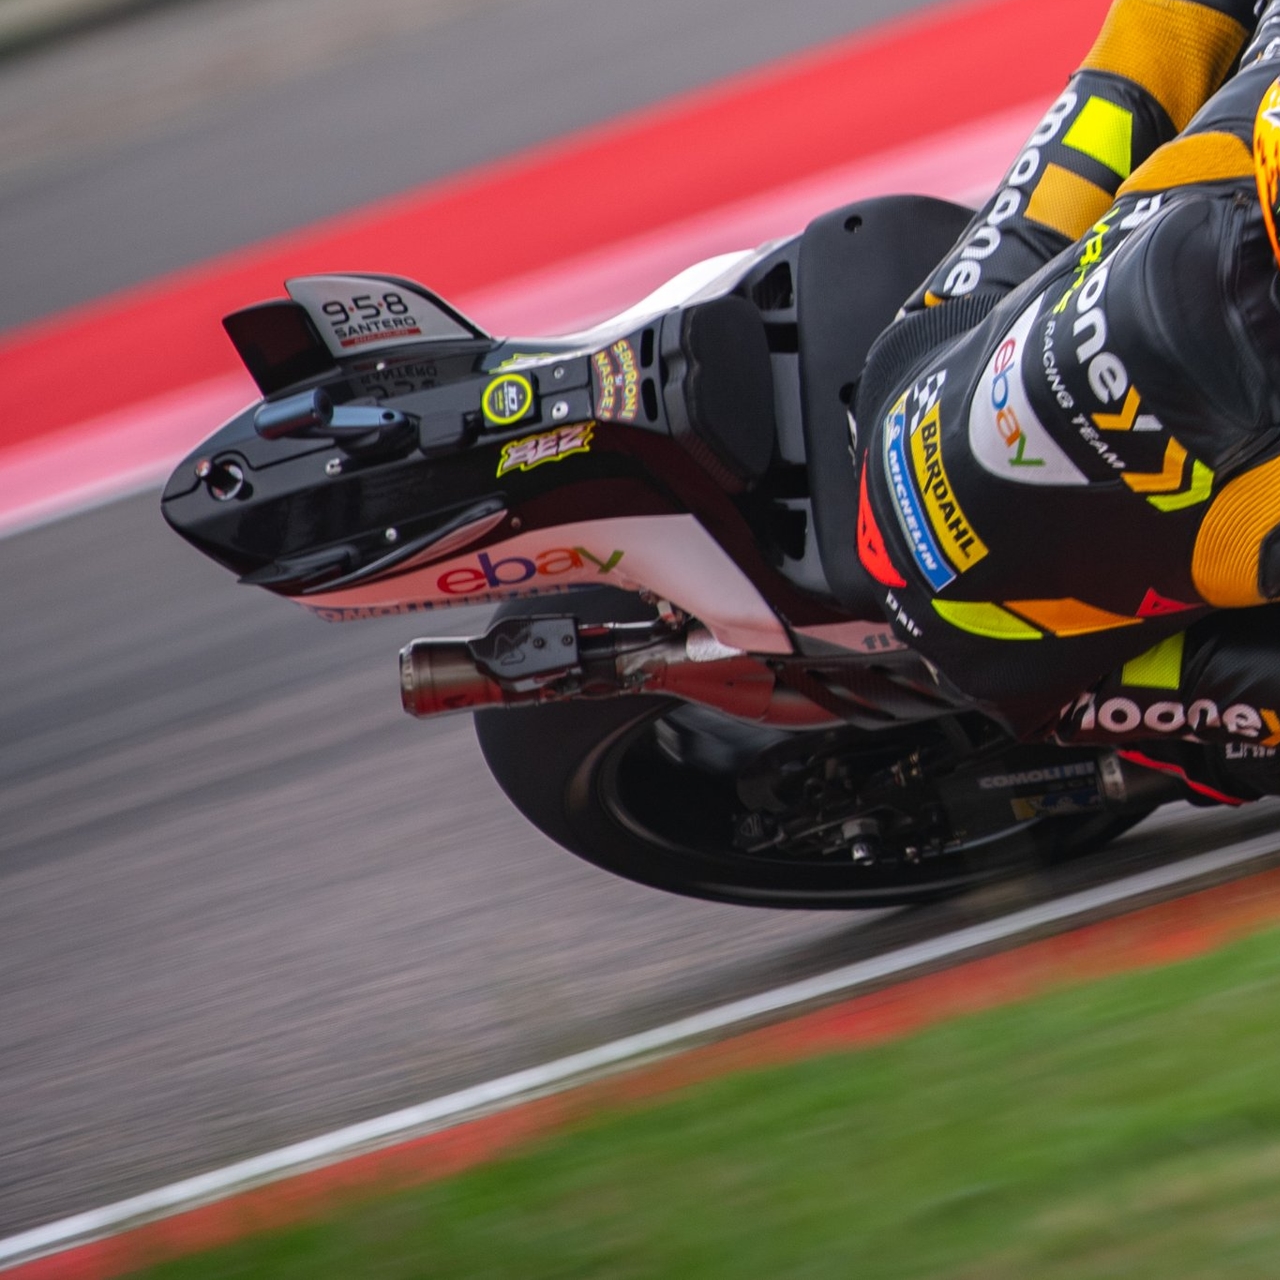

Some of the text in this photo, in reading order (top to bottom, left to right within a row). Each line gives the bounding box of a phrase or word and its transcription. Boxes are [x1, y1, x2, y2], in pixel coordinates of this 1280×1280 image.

[334, 315, 417, 340] SANTERO
[1043, 320, 1074, 410] RACING
[992, 336, 1046, 467] ebay
[1072, 413, 1126, 469] TEAM
[889, 450, 937, 571] MICHELIN
[921, 420, 978, 559] BARDAHL
[437, 546, 624, 595] ebay
